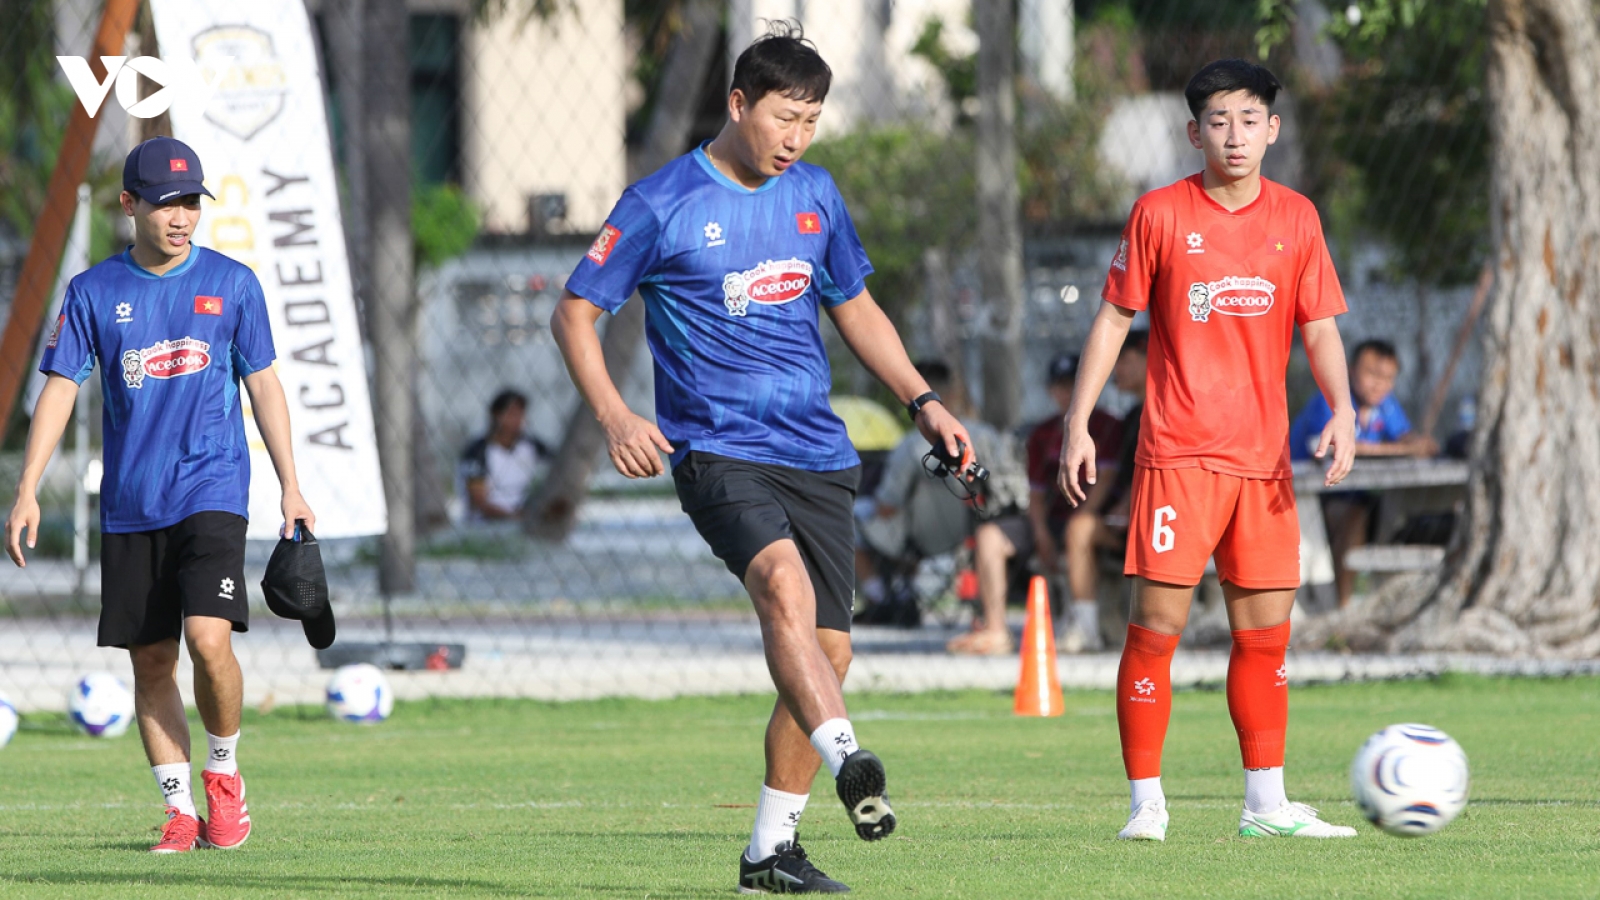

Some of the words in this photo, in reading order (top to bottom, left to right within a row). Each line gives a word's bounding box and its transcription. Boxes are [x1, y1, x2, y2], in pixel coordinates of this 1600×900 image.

[744, 263, 766, 281] Cook
[1209, 279, 1232, 292] Cook
[263, 168, 354, 451] ACADEMY
[141, 342, 163, 358] Cook
[1152, 505, 1177, 554] 6
